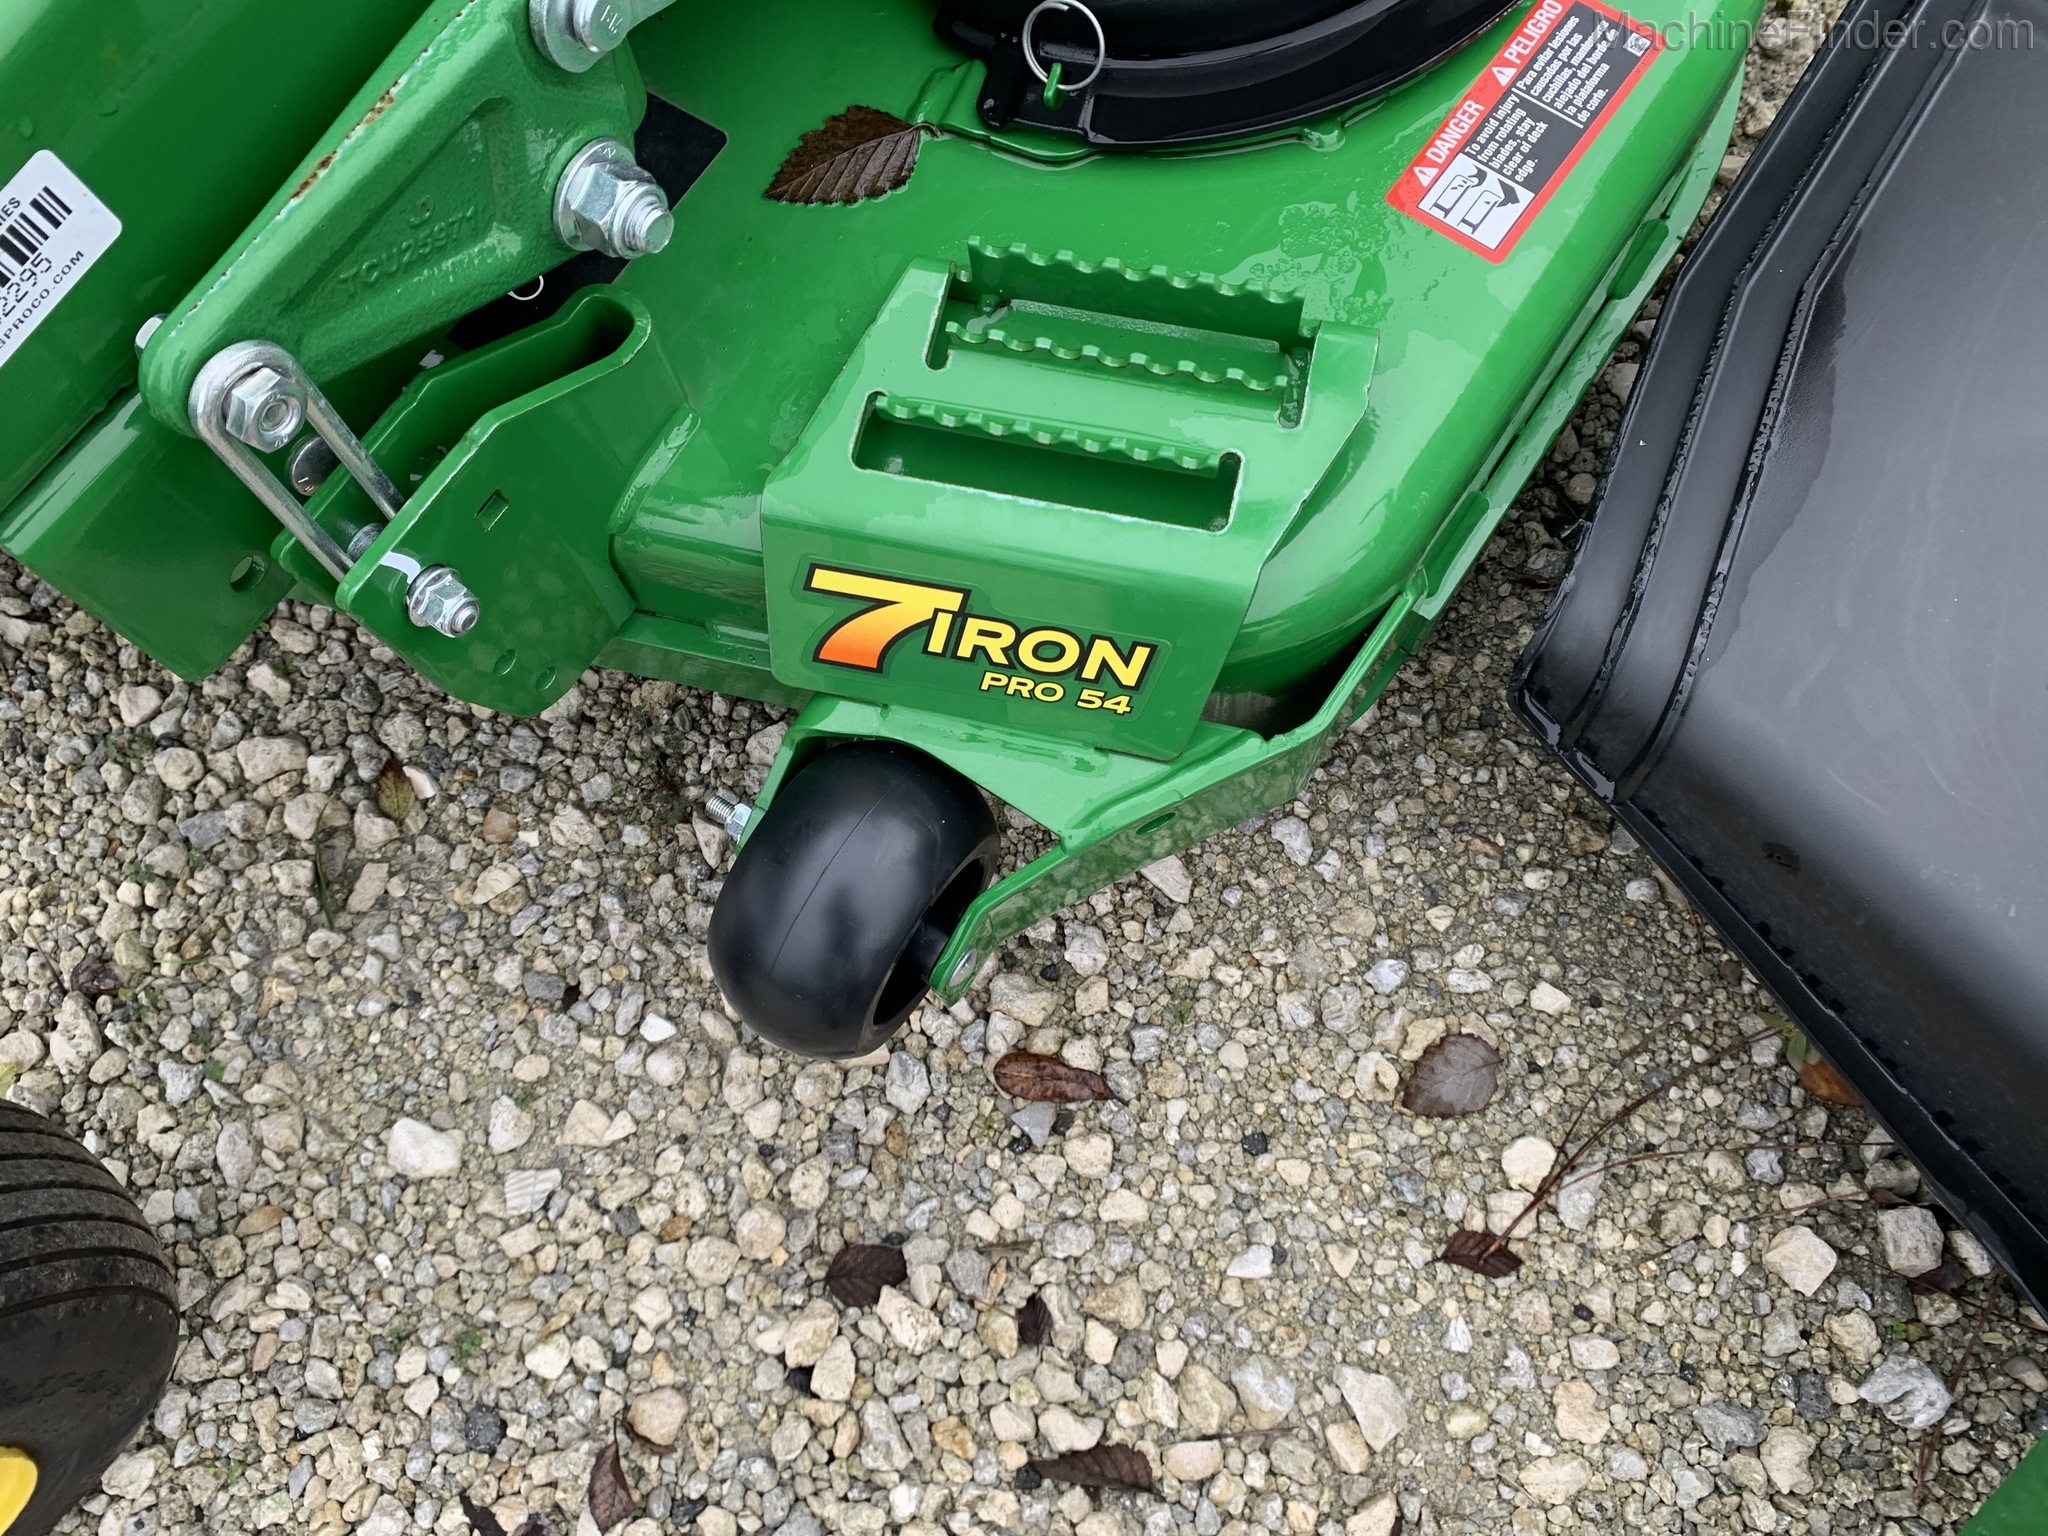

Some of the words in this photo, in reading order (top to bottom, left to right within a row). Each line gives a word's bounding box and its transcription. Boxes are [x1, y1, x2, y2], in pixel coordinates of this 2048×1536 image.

[1503, 0, 1563, 64] PELIGRO
[1516, 70, 1537, 90] Para
[1533, 47, 1554, 71] evitar
[1548, 16, 1580, 49] lesiones
[1530, 59, 1563, 96] causadas
[1558, 45, 1573, 62] por
[1566, 33, 1583, 47] las
[1542, 67, 1577, 103] cuchillas,
[1554, 77, 1582, 110] alejado
[1577, 63, 1593, 79] del
[1586, 40, 1610, 65] borde
[1606, 28, 1619, 41] de
[1563, 105, 1577, 116] la
[1573, 63, 1610, 108] plataforma
[1425, 100, 1485, 163] DANGER
[1465, 143, 1481, 155] To
[1477, 118, 1499, 144] avoid
[1493, 94, 1520, 120] injury
[1577, 110, 1590, 122] de
[1586, 89, 1609, 111] corte.
[1477, 141, 1500, 163] from
[1495, 108, 1527, 142] rotating
[1488, 139, 1521, 169] blades,
[1516, 117, 1535, 137] stay
[1502, 151, 1524, 176] clear
[1520, 140, 1532, 153] of
[1528, 121, 1549, 143] deck
[1514, 159, 1539, 182] edge.
[0, 197, 21, 227] IES
[0, 252, 52, 322] 2295
[803, 563, 972, 674] 7
[922, 607, 1158, 692] IRON
[979, 671, 1065, 703] PRO
[1075, 688, 1134, 716] 54
